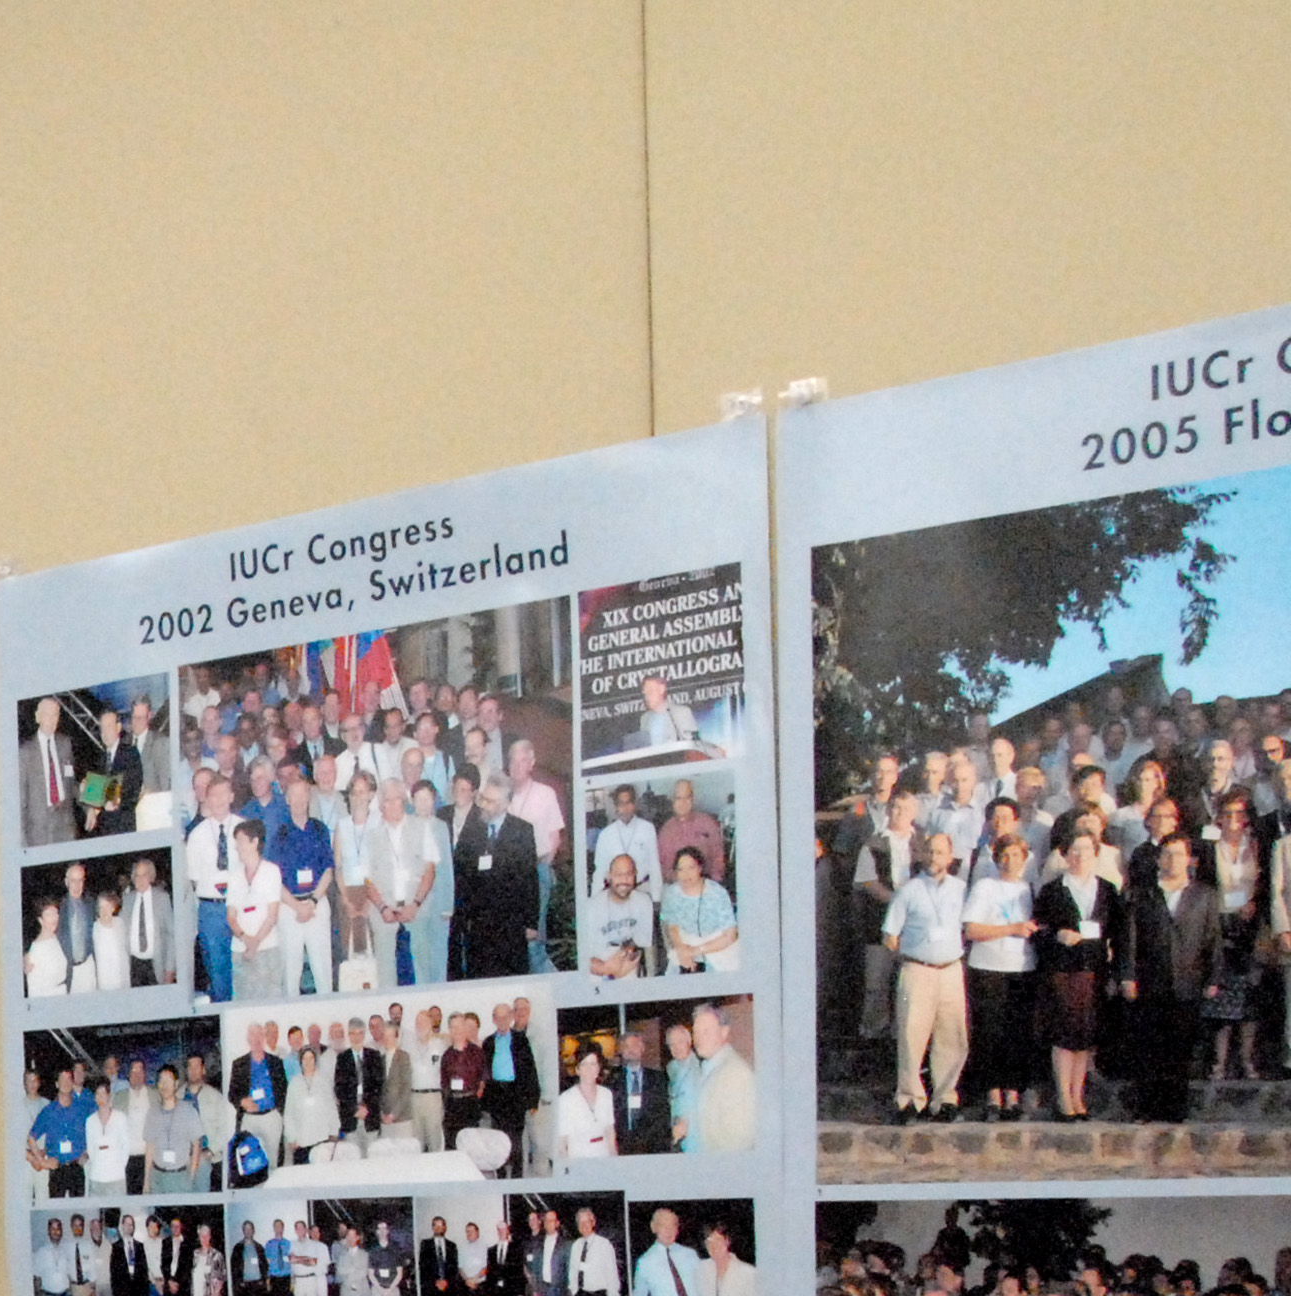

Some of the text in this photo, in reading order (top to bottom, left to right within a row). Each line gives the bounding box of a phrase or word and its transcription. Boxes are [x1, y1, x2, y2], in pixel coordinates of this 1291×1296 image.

[1150, 350, 1253, 400] IUCr
[1081, 414, 1200, 472] 2005
[229, 516, 455, 583] IUCr Congress
[138, 530, 570, 645] 2002 Geneva, Switzerland
[602, 608, 630, 628] XIX
[633, 590, 718, 621] CONGRESS
[588, 628, 660, 652] GENERAL
[608, 630, 737, 670] INTERNATIONAL
[592, 677, 615, 694] OF
[694, 683, 740, 701] AUGUST
